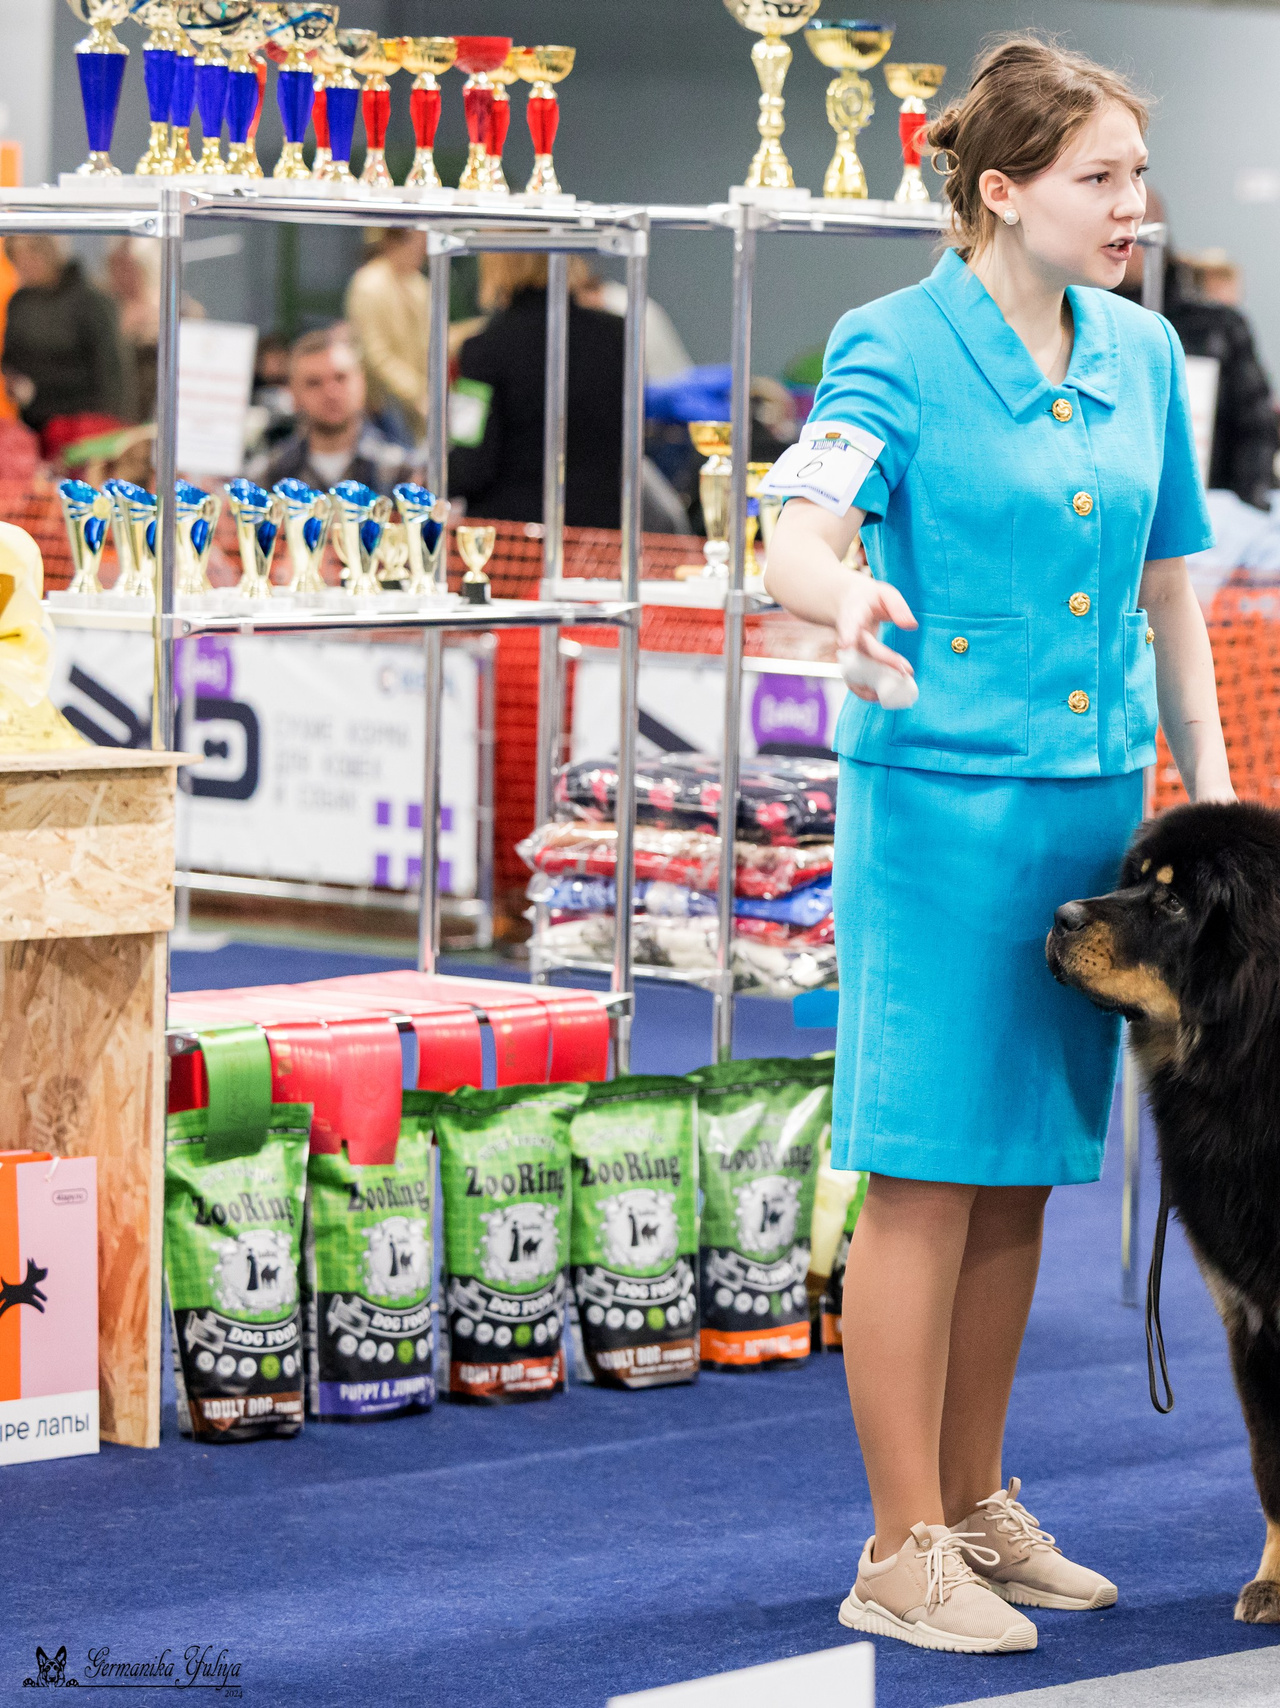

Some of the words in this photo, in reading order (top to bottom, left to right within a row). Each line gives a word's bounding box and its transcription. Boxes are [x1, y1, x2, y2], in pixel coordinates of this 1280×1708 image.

[465, 1161, 565, 1200] ZooRing
[578, 1151, 681, 1188] ZooRing
[228, 1325, 264, 1347] DOG
[266, 1321, 298, 1347] FOOD
[36, 1413, 90, 1439] лапы
